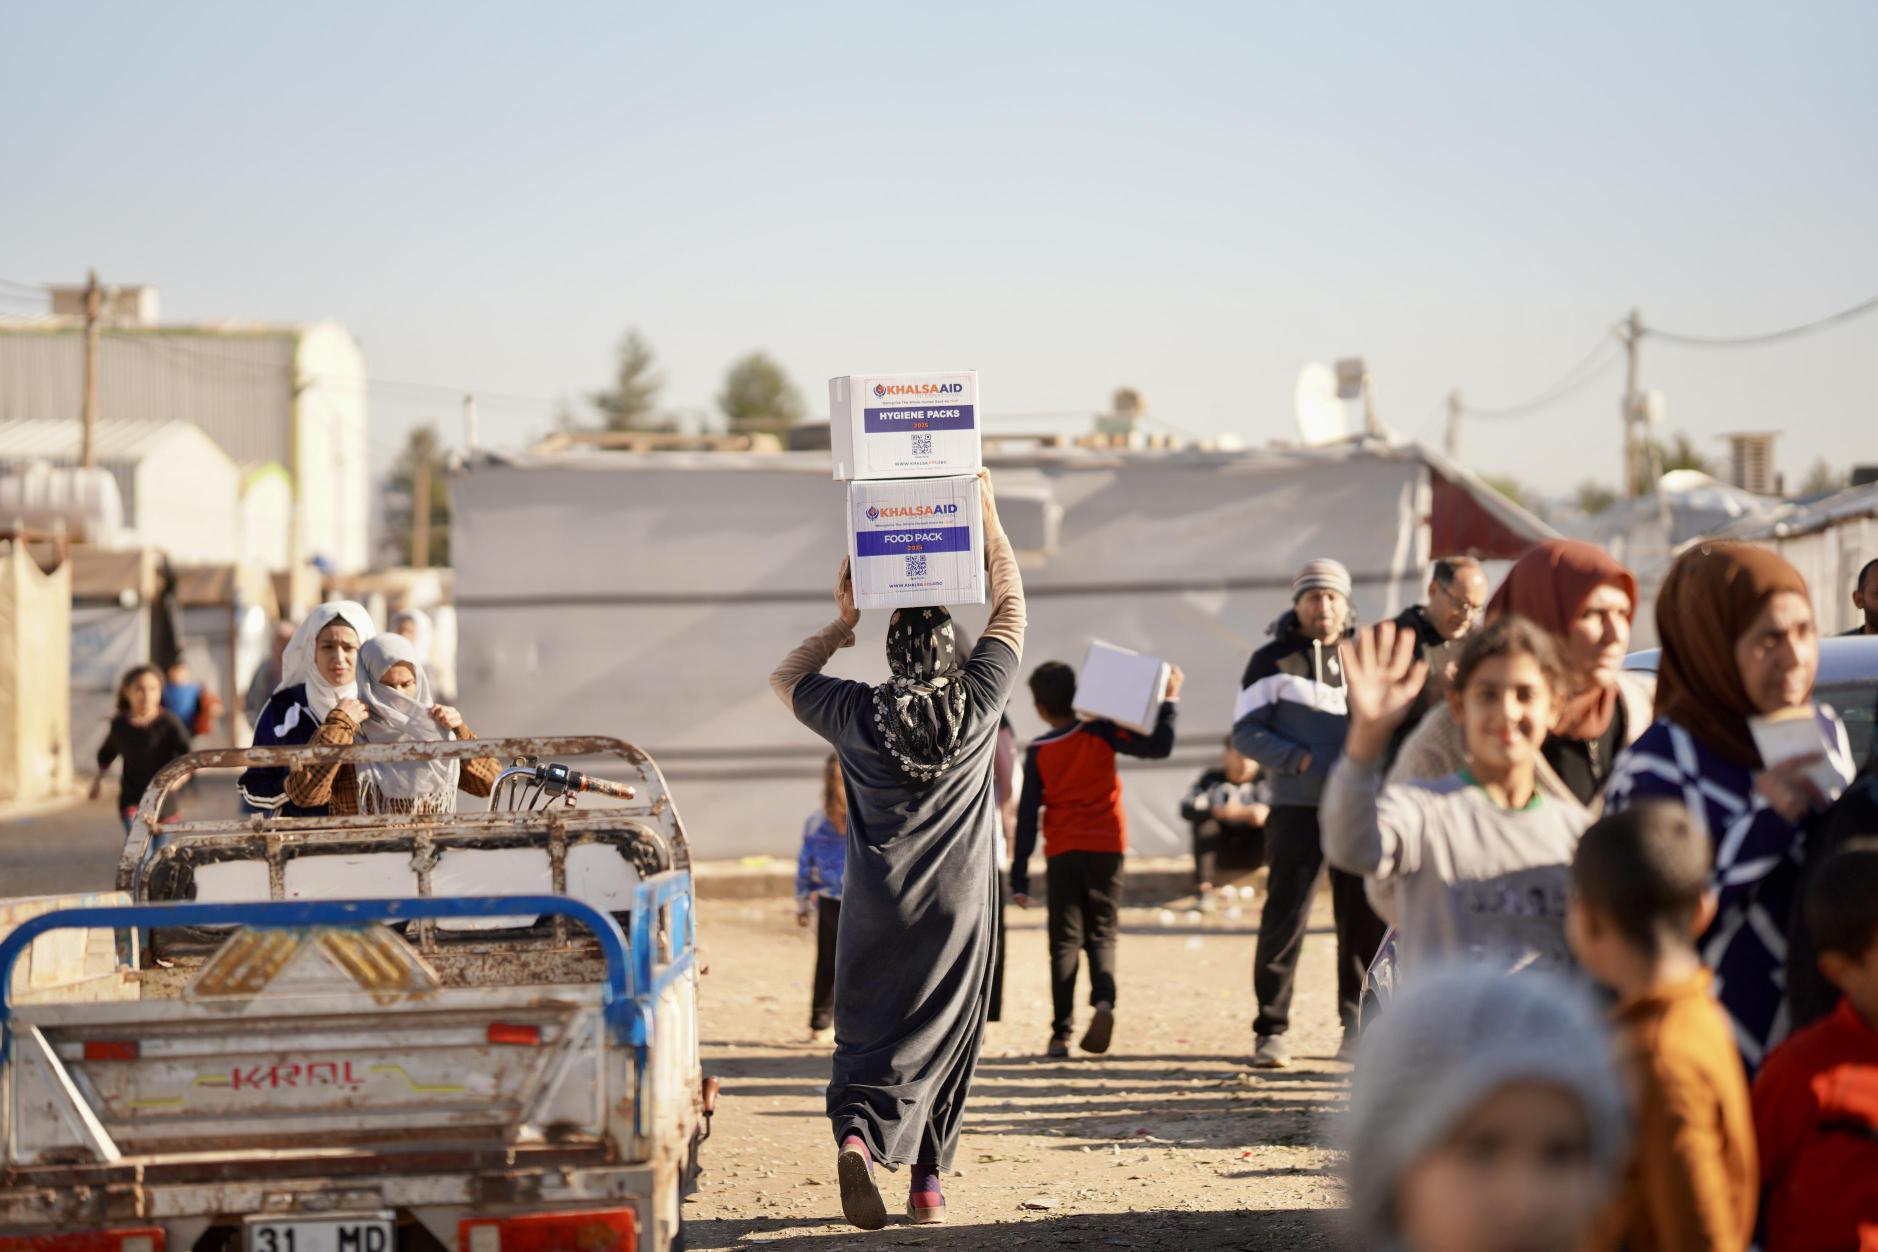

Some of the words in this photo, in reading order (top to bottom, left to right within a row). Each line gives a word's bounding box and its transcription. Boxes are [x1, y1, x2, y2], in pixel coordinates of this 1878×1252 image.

[880, 411, 924, 420] HYGIENE
[927, 409, 960, 419] PACKS
[884, 534, 914, 544] FOOD
[915, 532, 943, 542] PACK
[231, 1061, 365, 1091] KRAL
[257, 1227, 295, 1252] 31
[338, 1225, 386, 1252] MD
